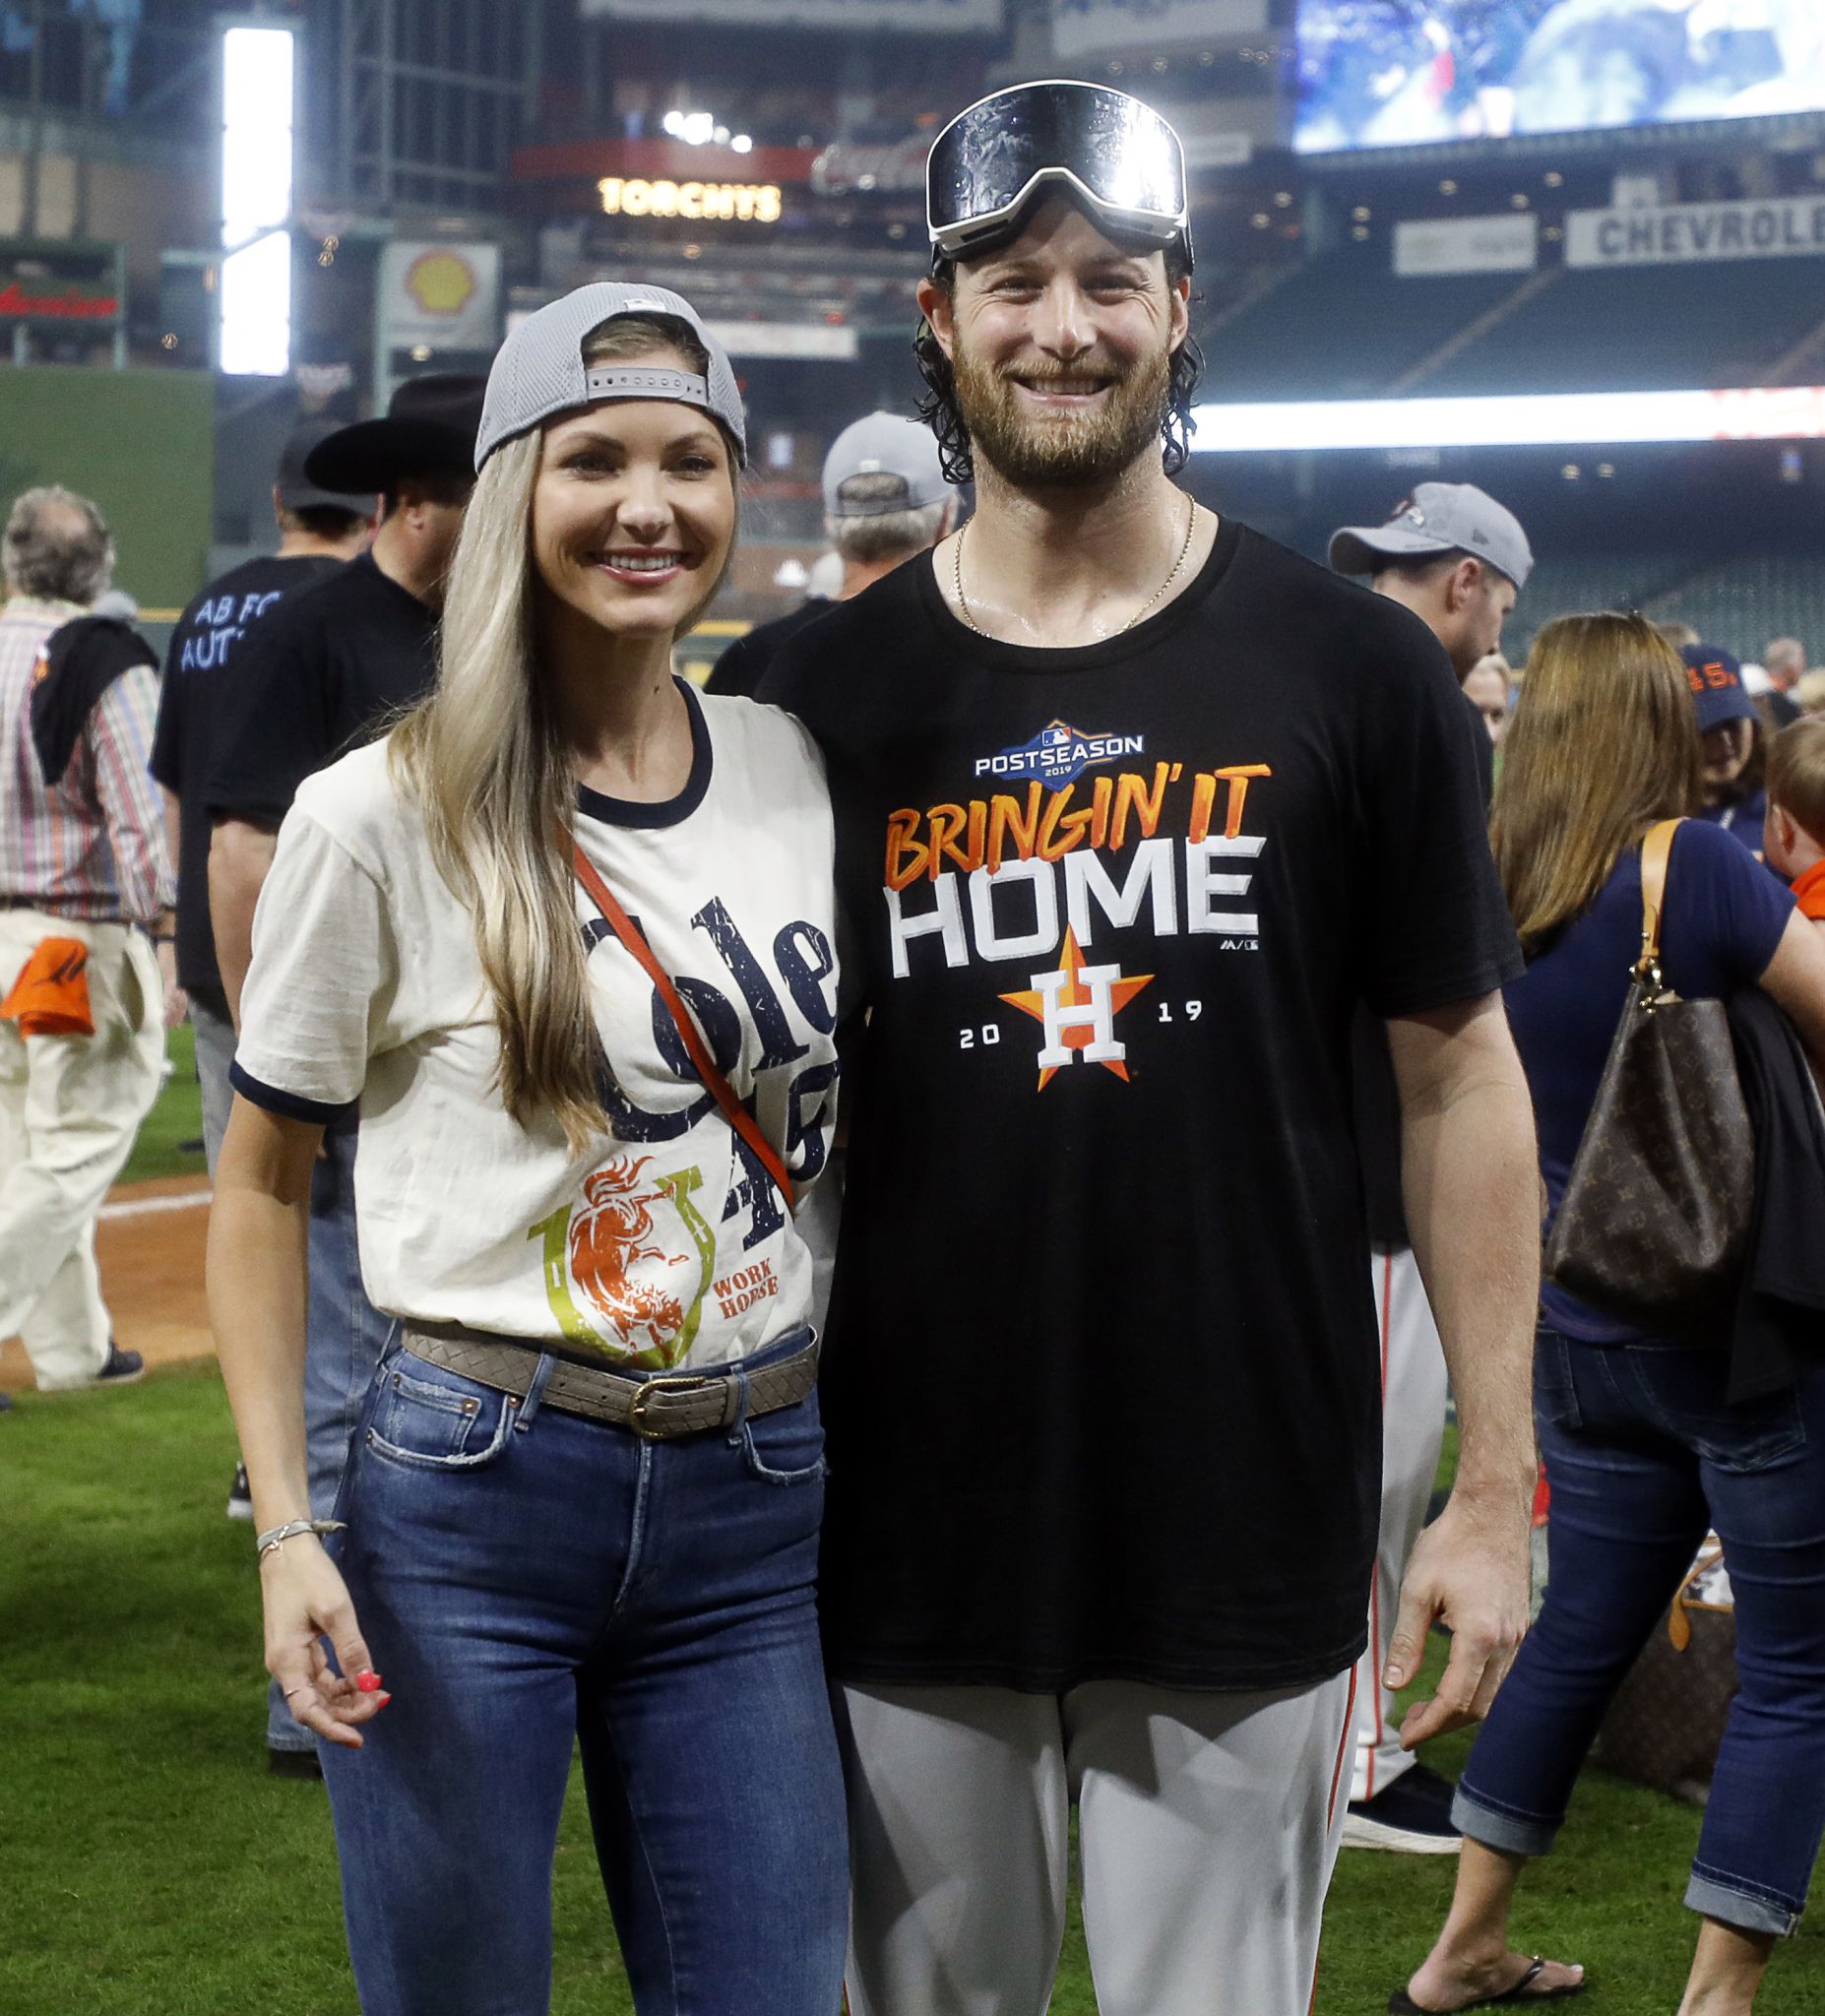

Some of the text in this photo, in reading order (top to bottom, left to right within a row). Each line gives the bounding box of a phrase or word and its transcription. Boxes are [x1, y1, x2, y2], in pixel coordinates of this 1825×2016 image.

[975, 735, 1144, 776] POSTSEASON
[1044, 765, 1073, 778] 2019
[1188, 763, 1273, 844] IT
[883, 837, 1268, 978] HOME
[713, 1257, 772, 1299] WORK
[719, 1276, 780, 1320] HORSE
